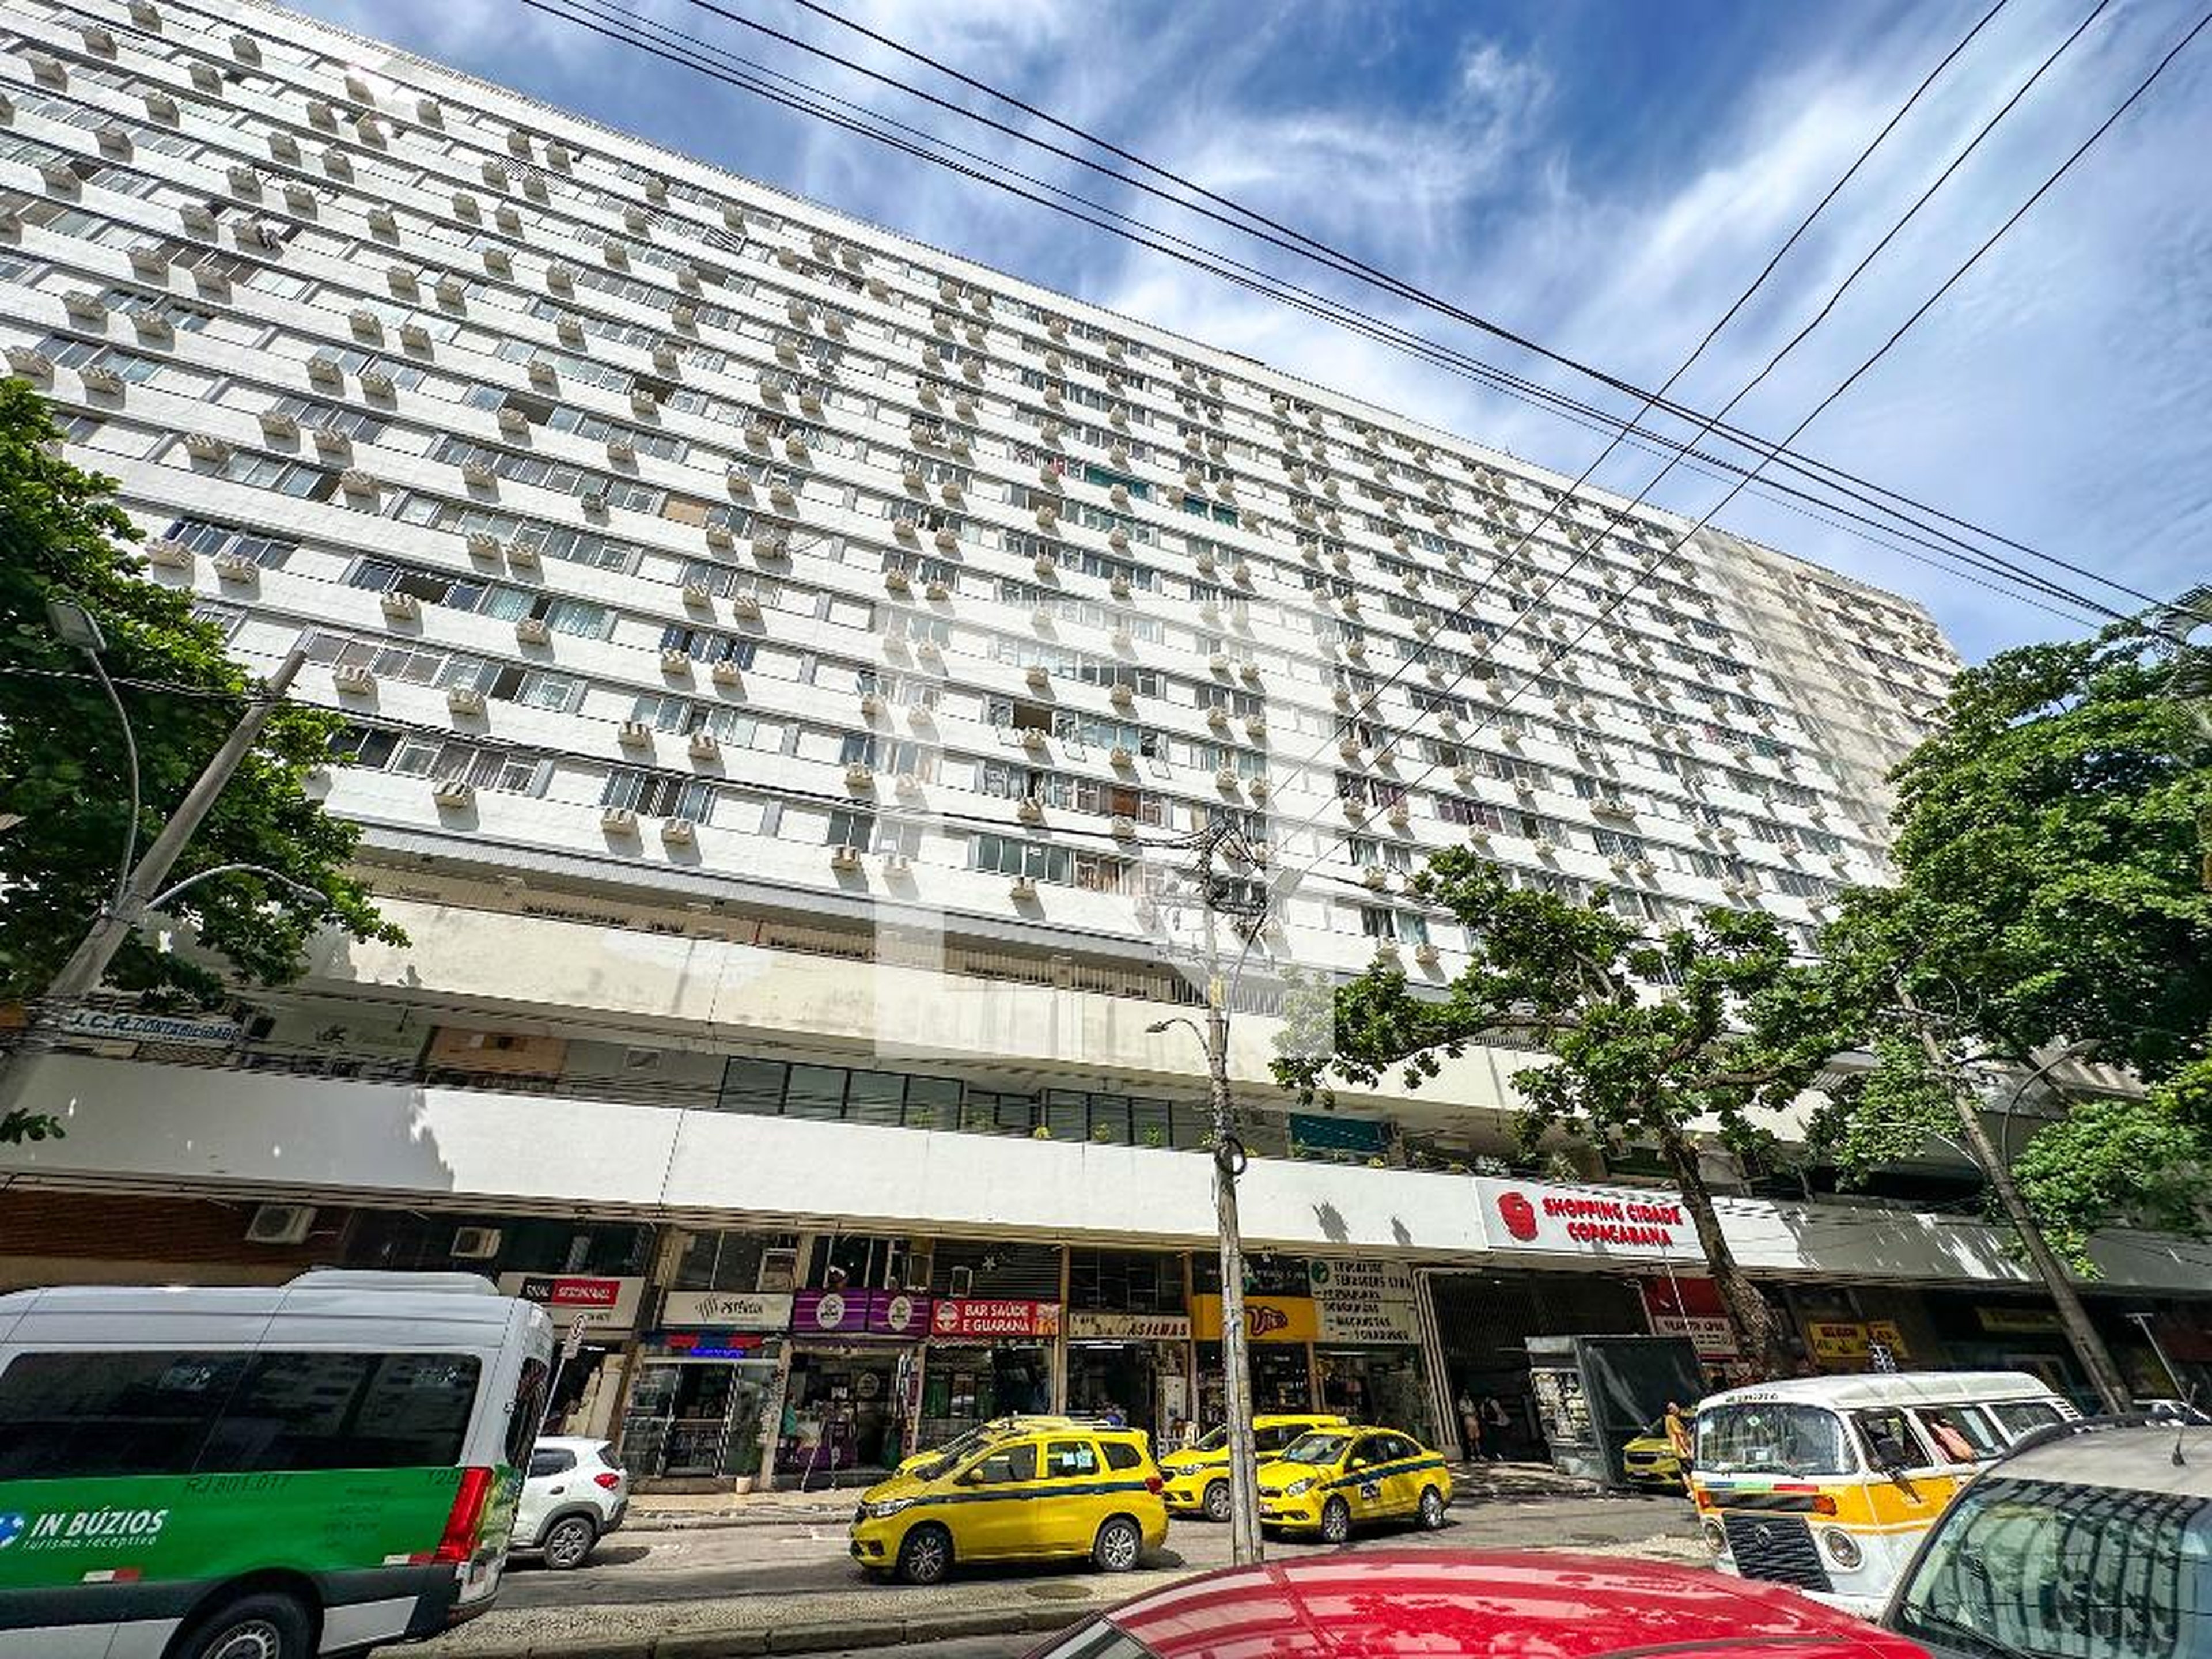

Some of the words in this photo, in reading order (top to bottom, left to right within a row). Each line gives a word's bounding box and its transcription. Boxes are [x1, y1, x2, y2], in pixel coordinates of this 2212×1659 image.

[1543, 1196, 1624, 1223] SHOPPING
[1626, 1203, 1683, 1226] CIDADE
[1567, 1222, 1673, 1247] COPACABANA
[964, 1304, 987, 1316] BAR
[991, 1301, 1029, 1317] SAÚDE
[963, 1319, 971, 1331] E
[29, 1513, 65, 1537] IN
[65, 1505, 169, 1536] BÚZIOS
[23, 1539, 81, 1550] turismo
[86, 1535, 157, 1548] receptivo
